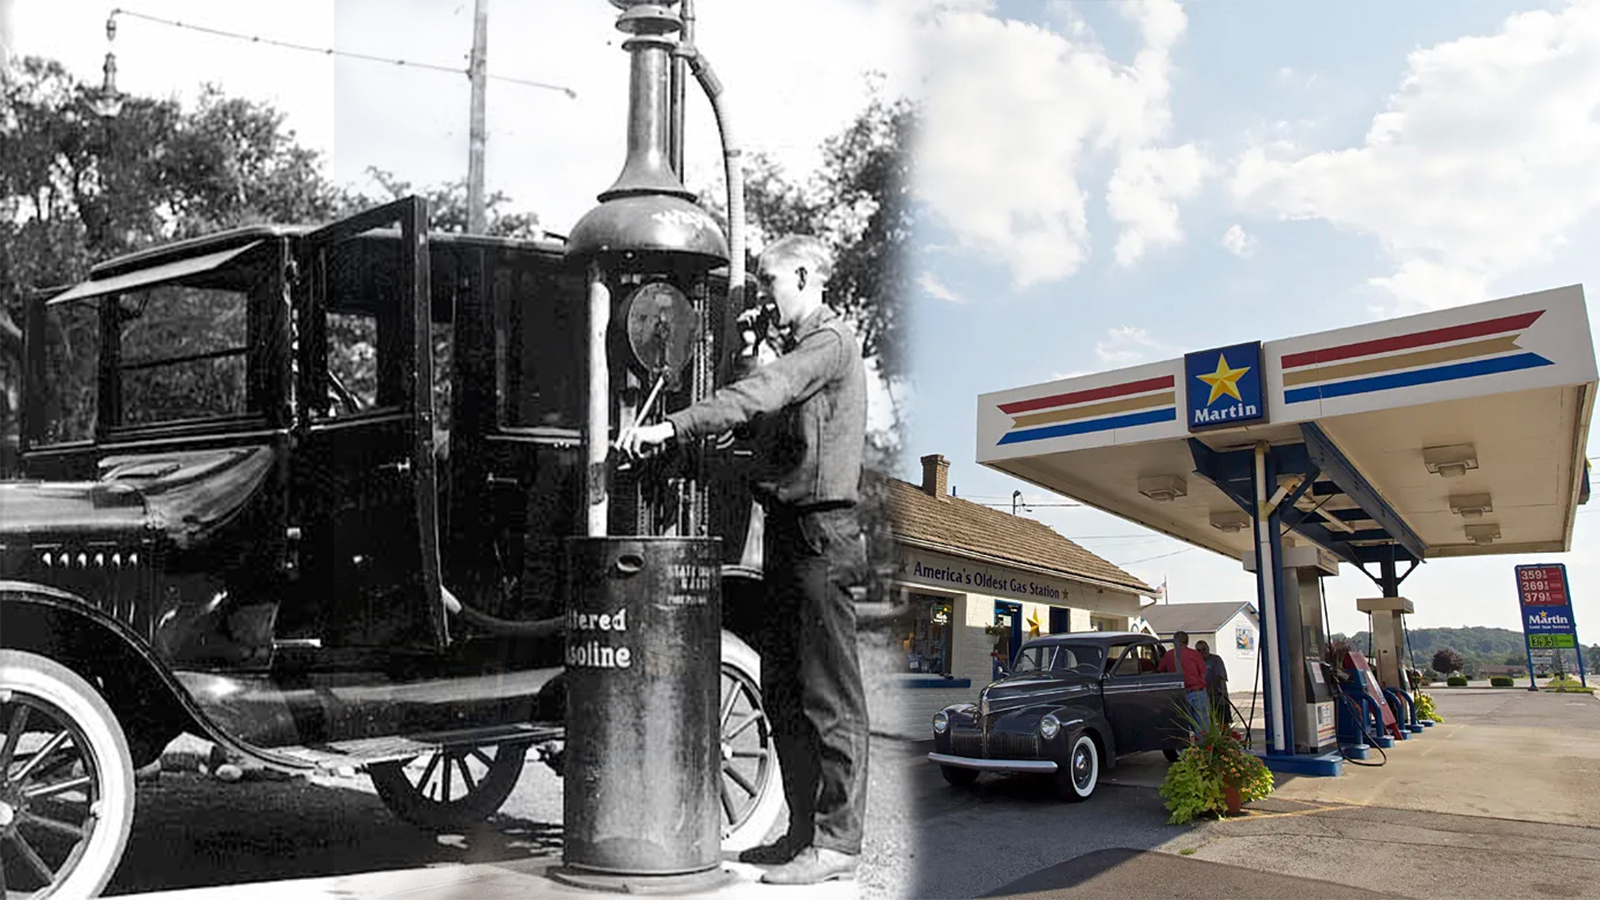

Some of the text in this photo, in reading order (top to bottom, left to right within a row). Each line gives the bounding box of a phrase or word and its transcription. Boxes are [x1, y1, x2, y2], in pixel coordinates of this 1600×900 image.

[1194, 402, 1257, 423] Martin
[1521, 570, 1542, 580] 359
[913, 561, 1060, 600] America's Oldest Gas Station
[1523, 581, 1544, 591] 369
[1525, 592, 1546, 602] 379
[1529, 615, 1568, 624] Martin
